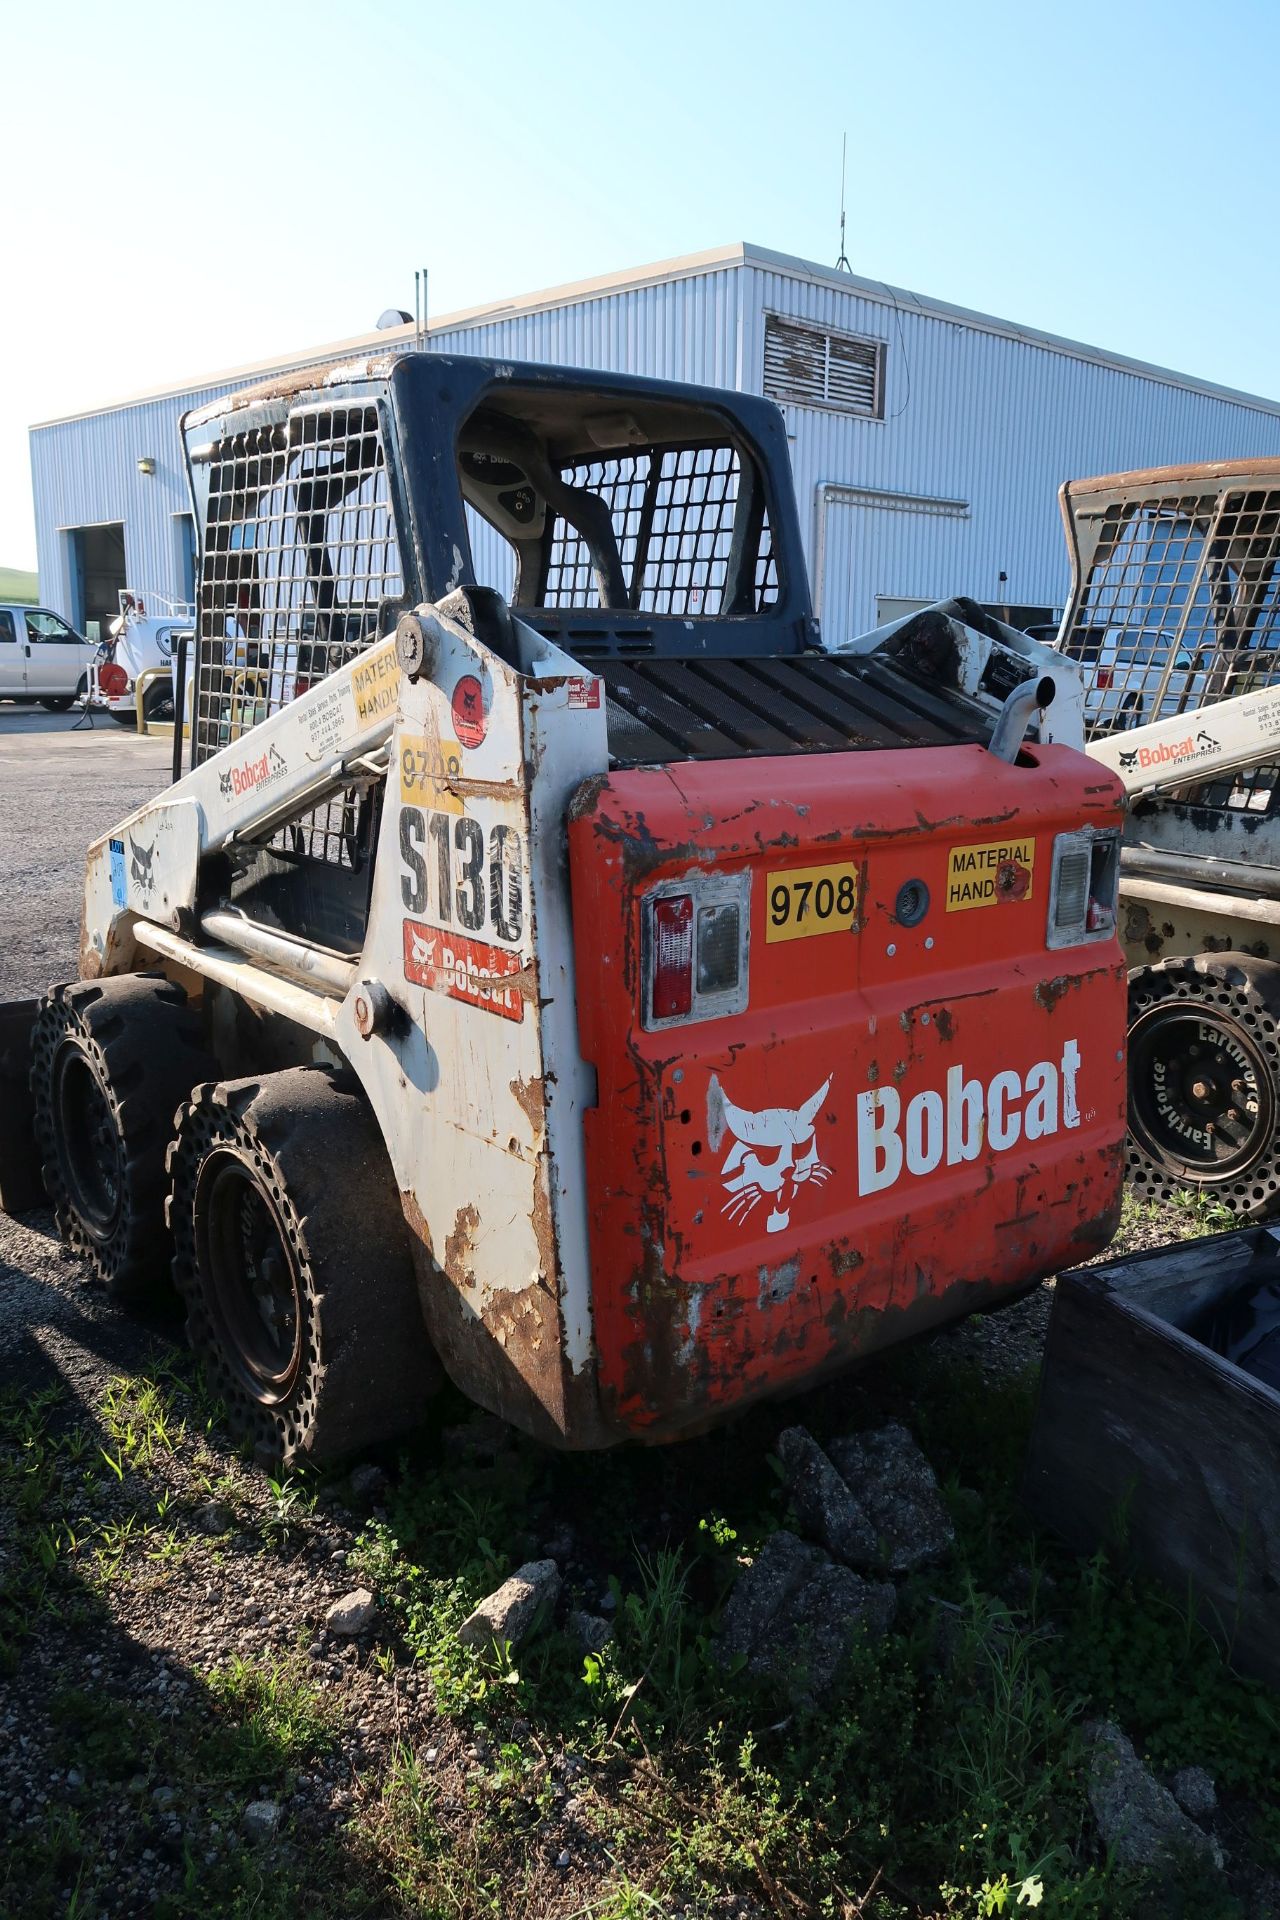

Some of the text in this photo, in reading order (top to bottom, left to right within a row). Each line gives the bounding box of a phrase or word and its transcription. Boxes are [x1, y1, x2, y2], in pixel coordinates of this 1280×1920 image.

[355, 650, 397, 693] MATERI
[359, 681, 399, 718] HANDLI
[1138, 735, 1196, 768] Bobcat
[1173, 745, 1222, 765] ENTERPRISES
[232, 752, 270, 796] Bobcat
[256, 766, 288, 792] ENTERPRISES
[111, 840, 123, 854] LOT
[952, 845, 1031, 873] MATERIAL
[399, 806, 523, 942] S130
[950, 879, 995, 903] HAND
[770, 875, 855, 926] 9708
[857, 1039, 1081, 1197] Bobcat
